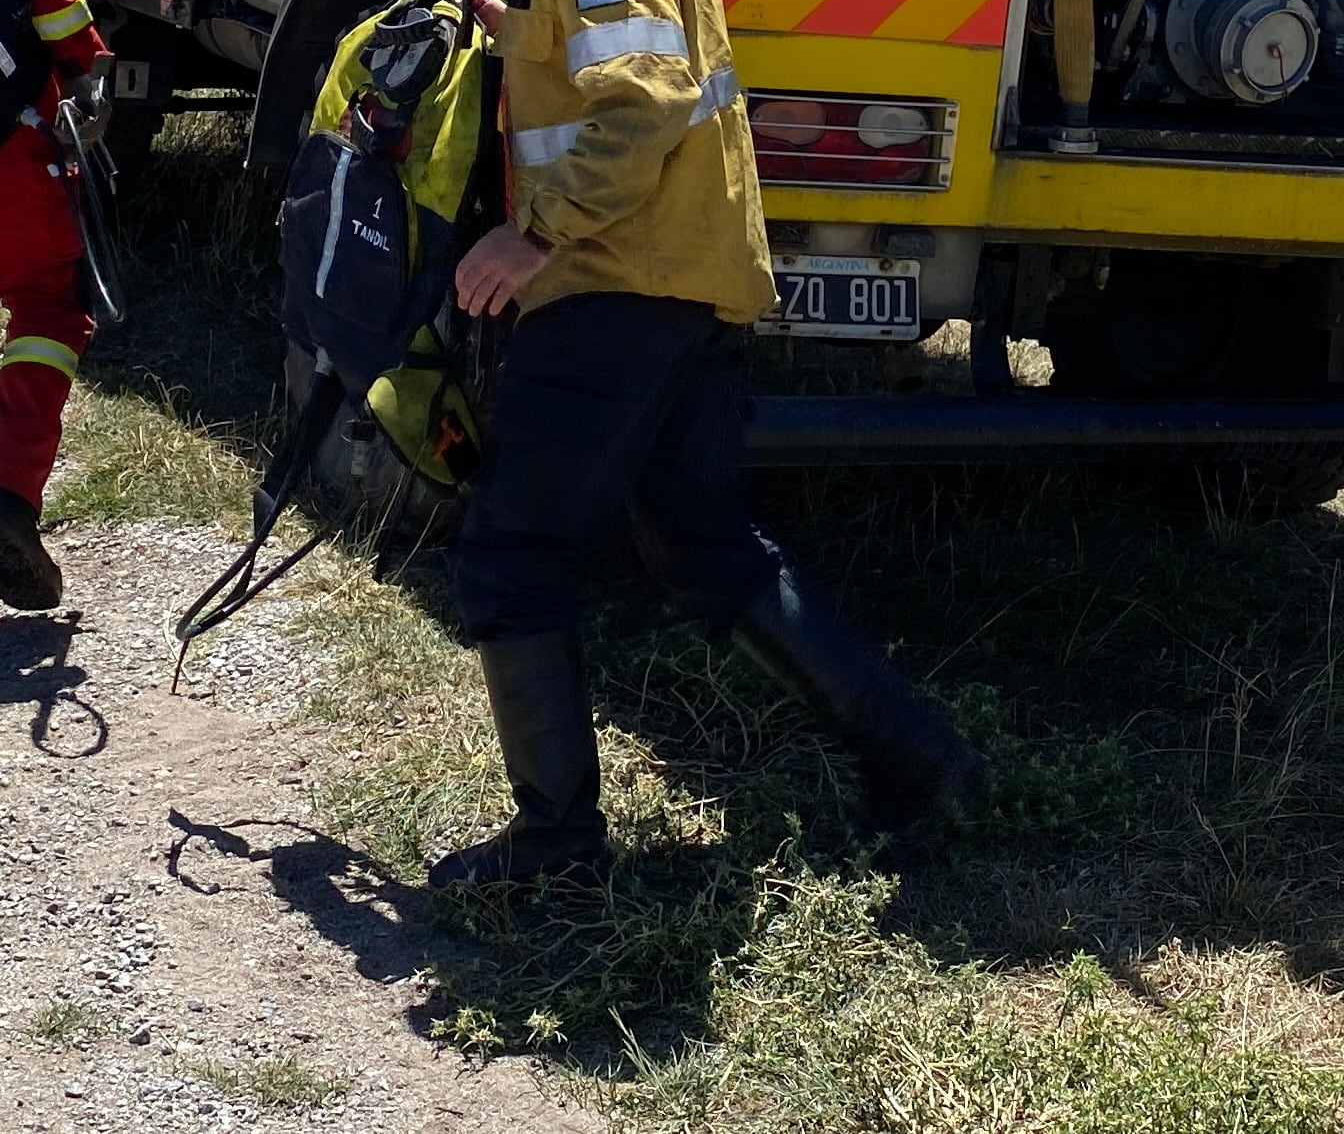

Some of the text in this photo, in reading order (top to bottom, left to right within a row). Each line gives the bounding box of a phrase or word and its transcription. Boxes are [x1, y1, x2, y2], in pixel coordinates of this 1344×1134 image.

[372, 197, 383, 220] 1
[352, 219, 390, 252] TANDIL
[807, 258, 869, 271] ARGENTINA
[774, 275, 913, 323] ZQ 801
